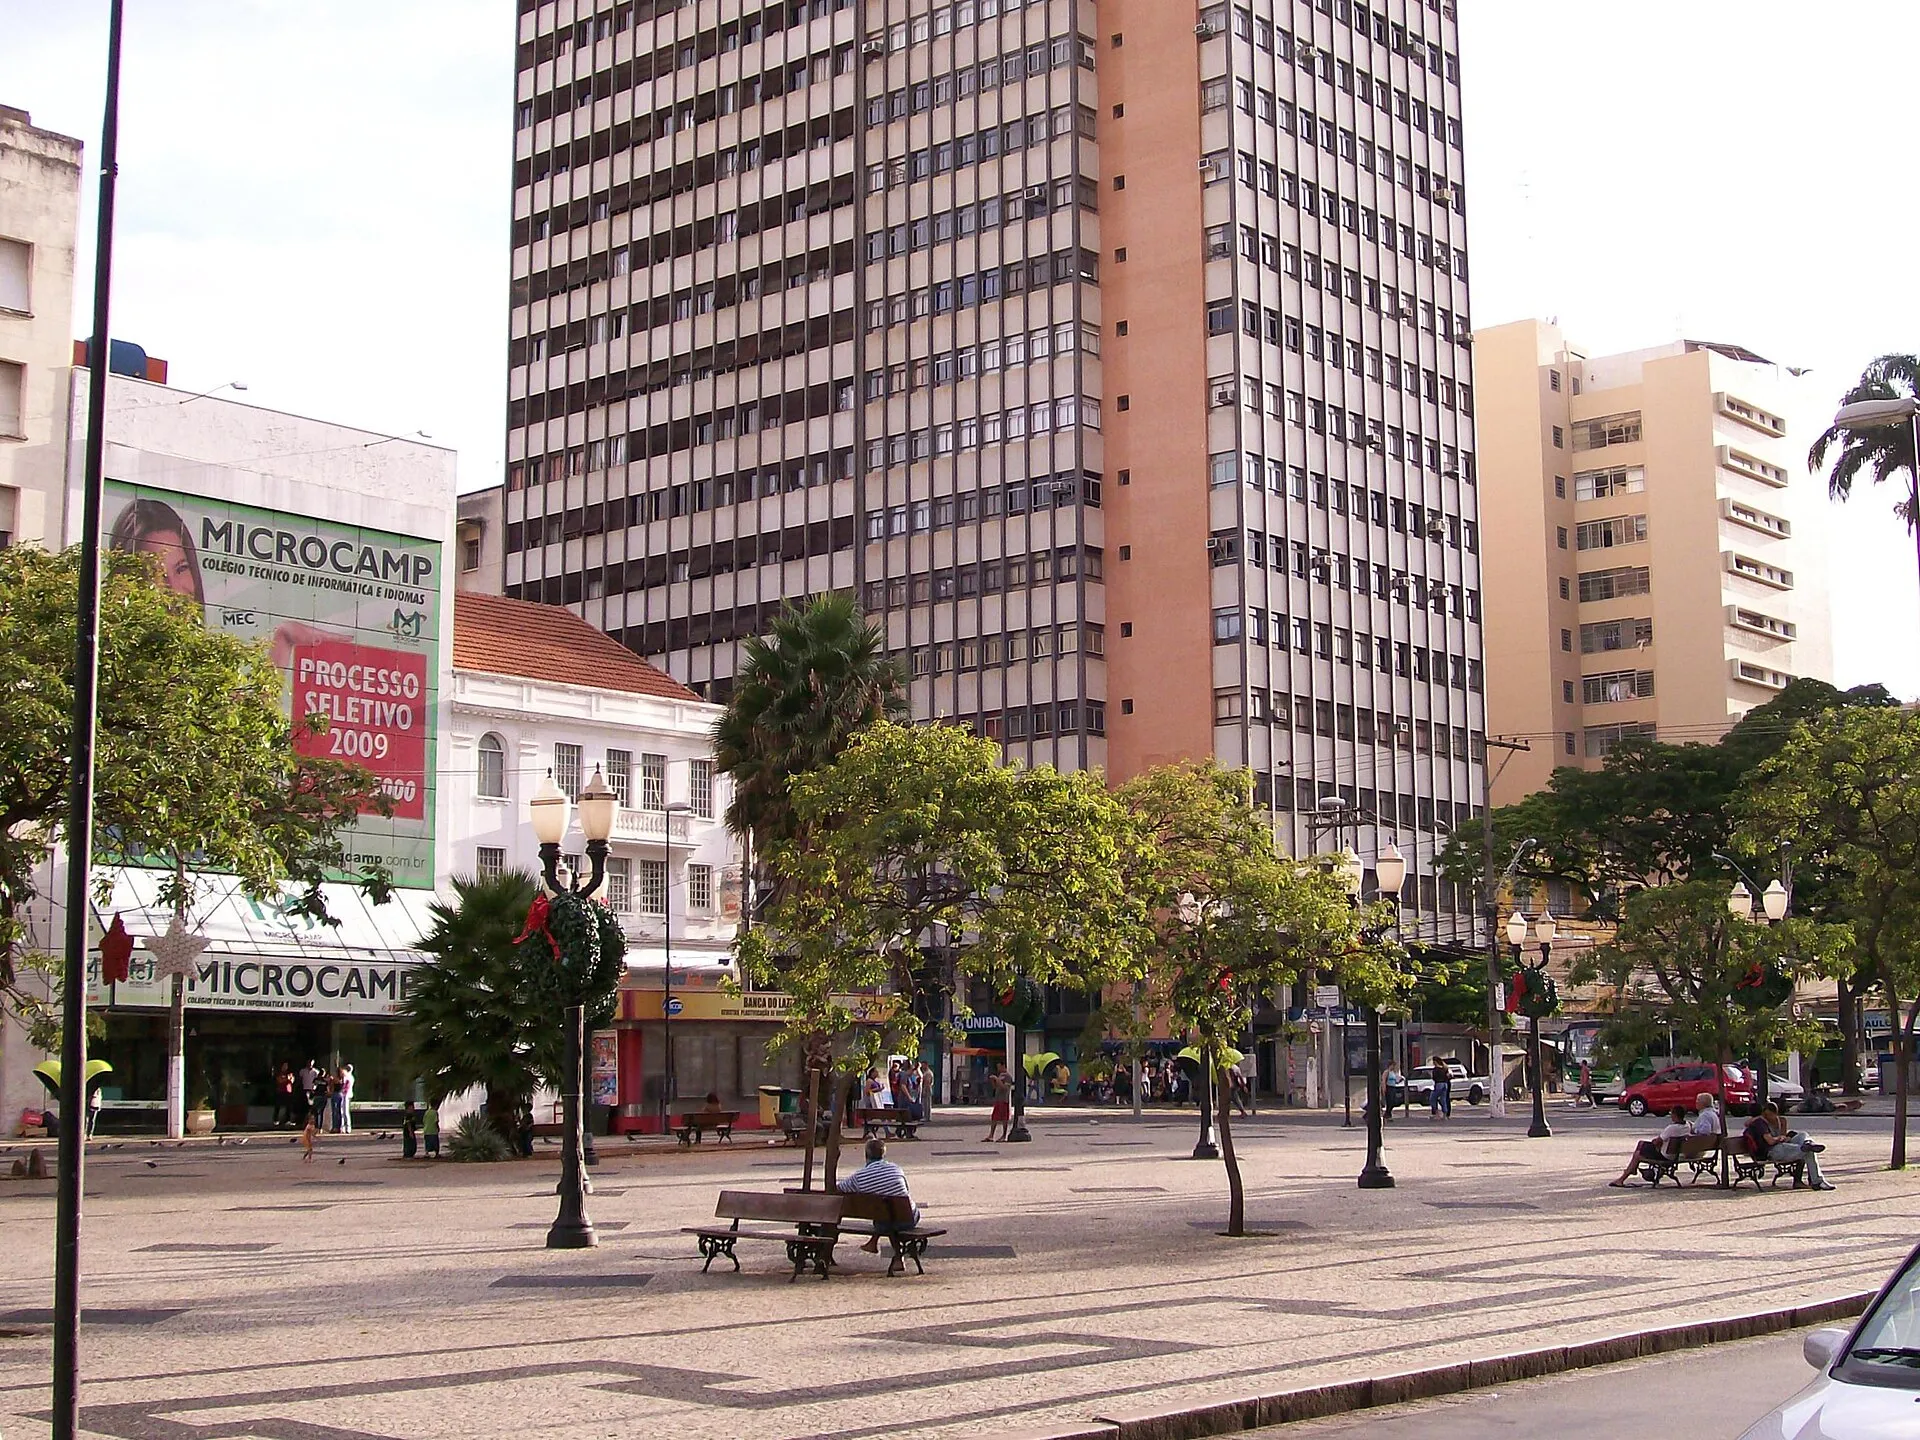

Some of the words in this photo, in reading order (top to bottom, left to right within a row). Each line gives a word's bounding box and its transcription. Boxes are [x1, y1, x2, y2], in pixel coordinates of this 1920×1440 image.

[201, 516, 433, 586] MICROCAMP
[248, 563, 290, 583] TÉCNICO
[292, 572, 306, 586] DE
[307, 575, 374, 597] INFORMÁTICA
[376, 586, 382, 598] E
[383, 587, 426, 606] IDIOMAS
[222, 612, 256, 626] MEC
[299, 657, 420, 699] PROCESSO
[304, 690, 413, 730] SELETIVO
[329, 727, 389, 760] 2009
[743, 997, 767, 1009] BANCA
[768, 997, 778, 1009] DO
